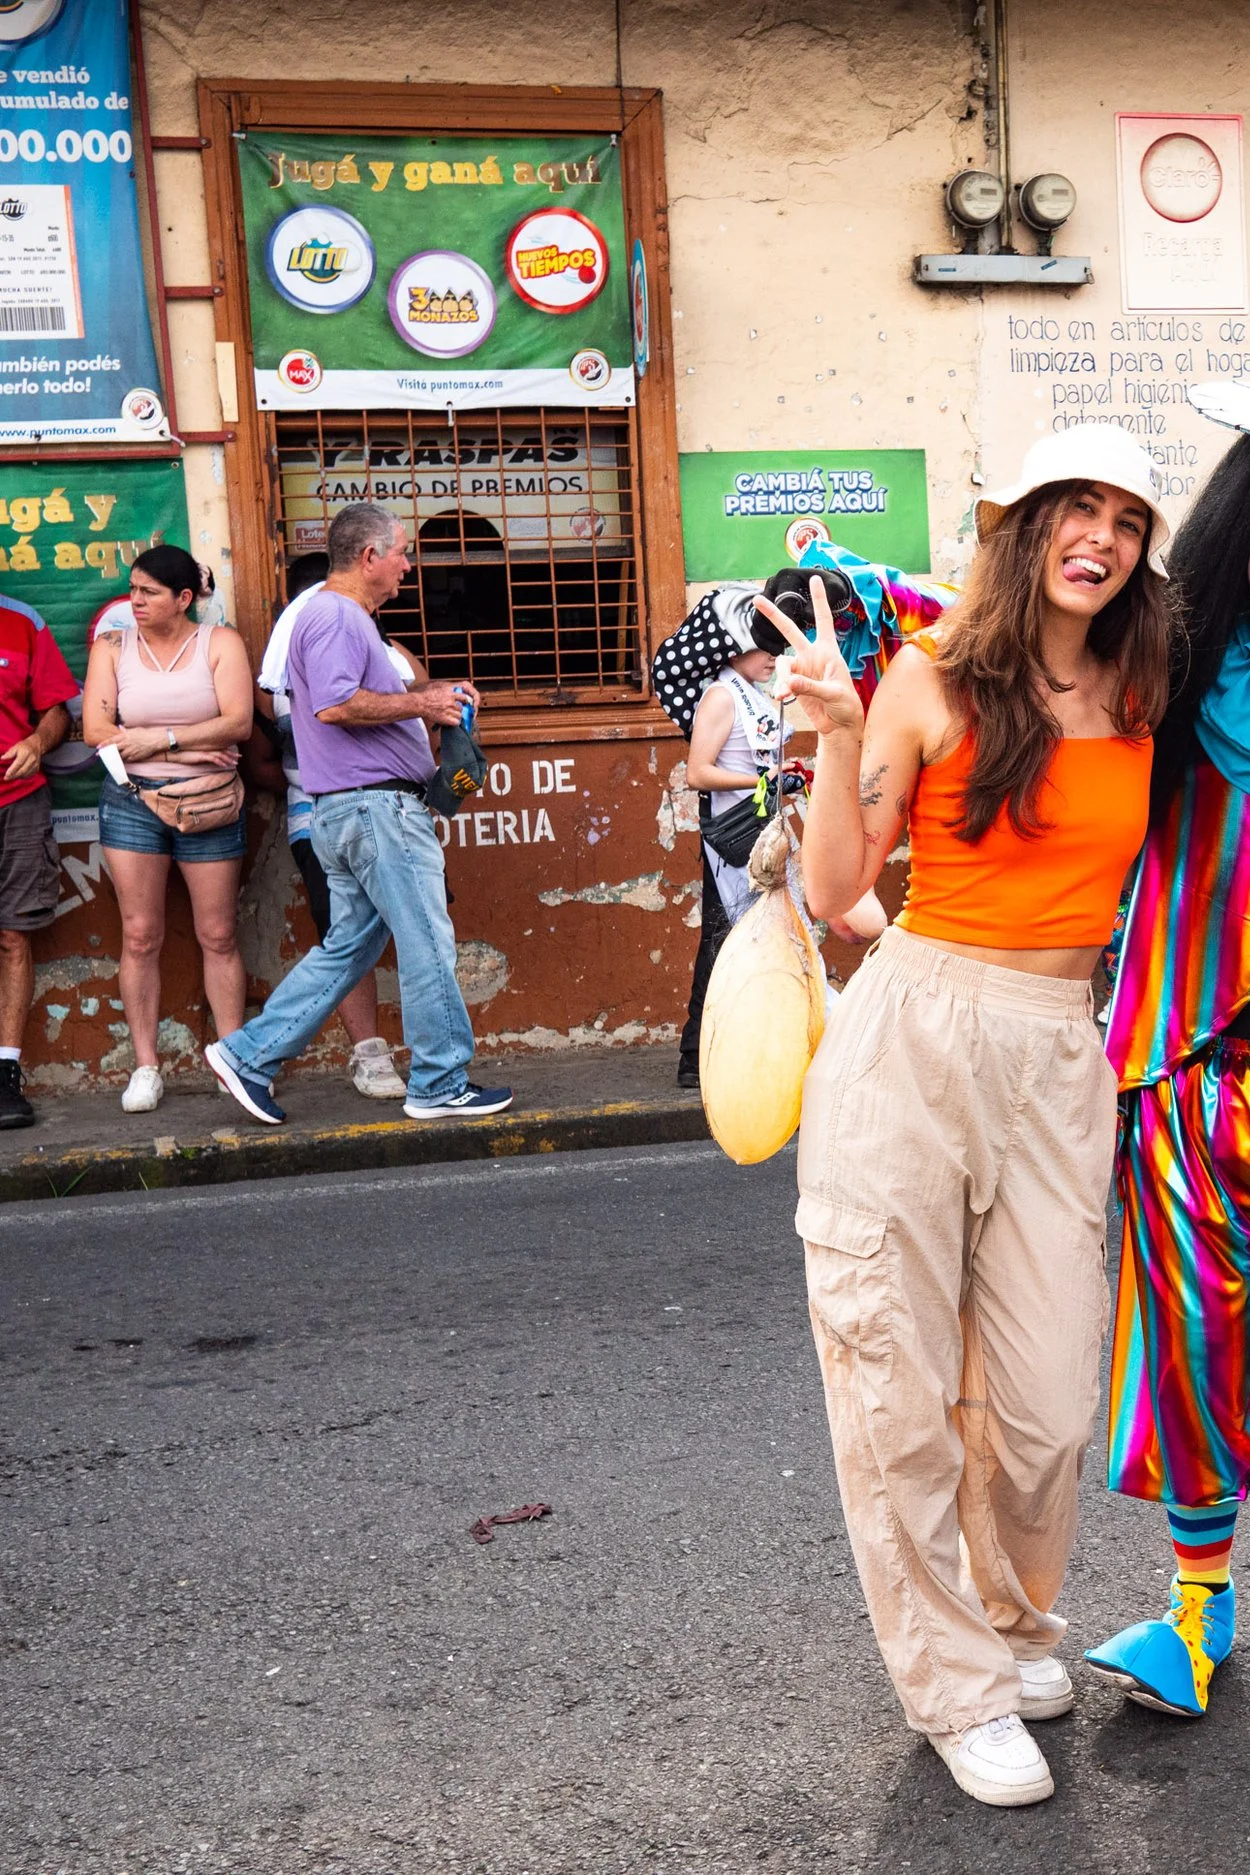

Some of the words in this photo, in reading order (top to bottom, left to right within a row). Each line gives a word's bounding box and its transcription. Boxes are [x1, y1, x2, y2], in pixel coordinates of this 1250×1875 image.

[13, 65, 91, 84] vendió
[104, 92, 129, 110] de
[268, 153, 360, 191] Jugá
[368, 161, 395, 192] y
[403, 154, 503, 192] ganá
[513, 155, 603, 193] aquí
[287, 247, 348, 272] LOTTO
[517, 246, 558, 262] NUEVOS
[518, 250, 596, 279] TIEMPOS
[409, 287, 430, 310] 3
[408, 310, 479, 323] MONAZOS
[1008, 315, 1060, 341] todo
[1068, 320, 1096, 342] en
[1110, 316, 1204, 342] artículos
[1219, 318, 1246, 345] de
[0, 356, 59, 372] mbién
[65, 355, 121, 375] podés
[1010, 348, 1096, 377] limpieza
[1110, 351, 1164, 377] para
[1175, 348, 1194, 375] el
[44, 377, 91, 393] todo!
[431, 379, 504, 392] puntomax.com
[1053, 378, 1113, 409] papel
[1124, 378, 1198, 410] higiéni
[308, 440, 355, 468] Y
[369, 436, 580, 467] RASPAS
[1140, 440, 1199, 468] tante
[316, 480, 422, 502] CAMBIO
[432, 478, 461, 498] DE
[472, 476, 583, 498] PREMIOS
[735, 468, 826, 494] CAMBIÁ
[829, 471, 873, 491] TUS
[85, 494, 117, 531] y
[725, 493, 825, 516] PREMIOS
[828, 488, 888, 514] AQUÍ
[532, 759, 577, 794] DE
